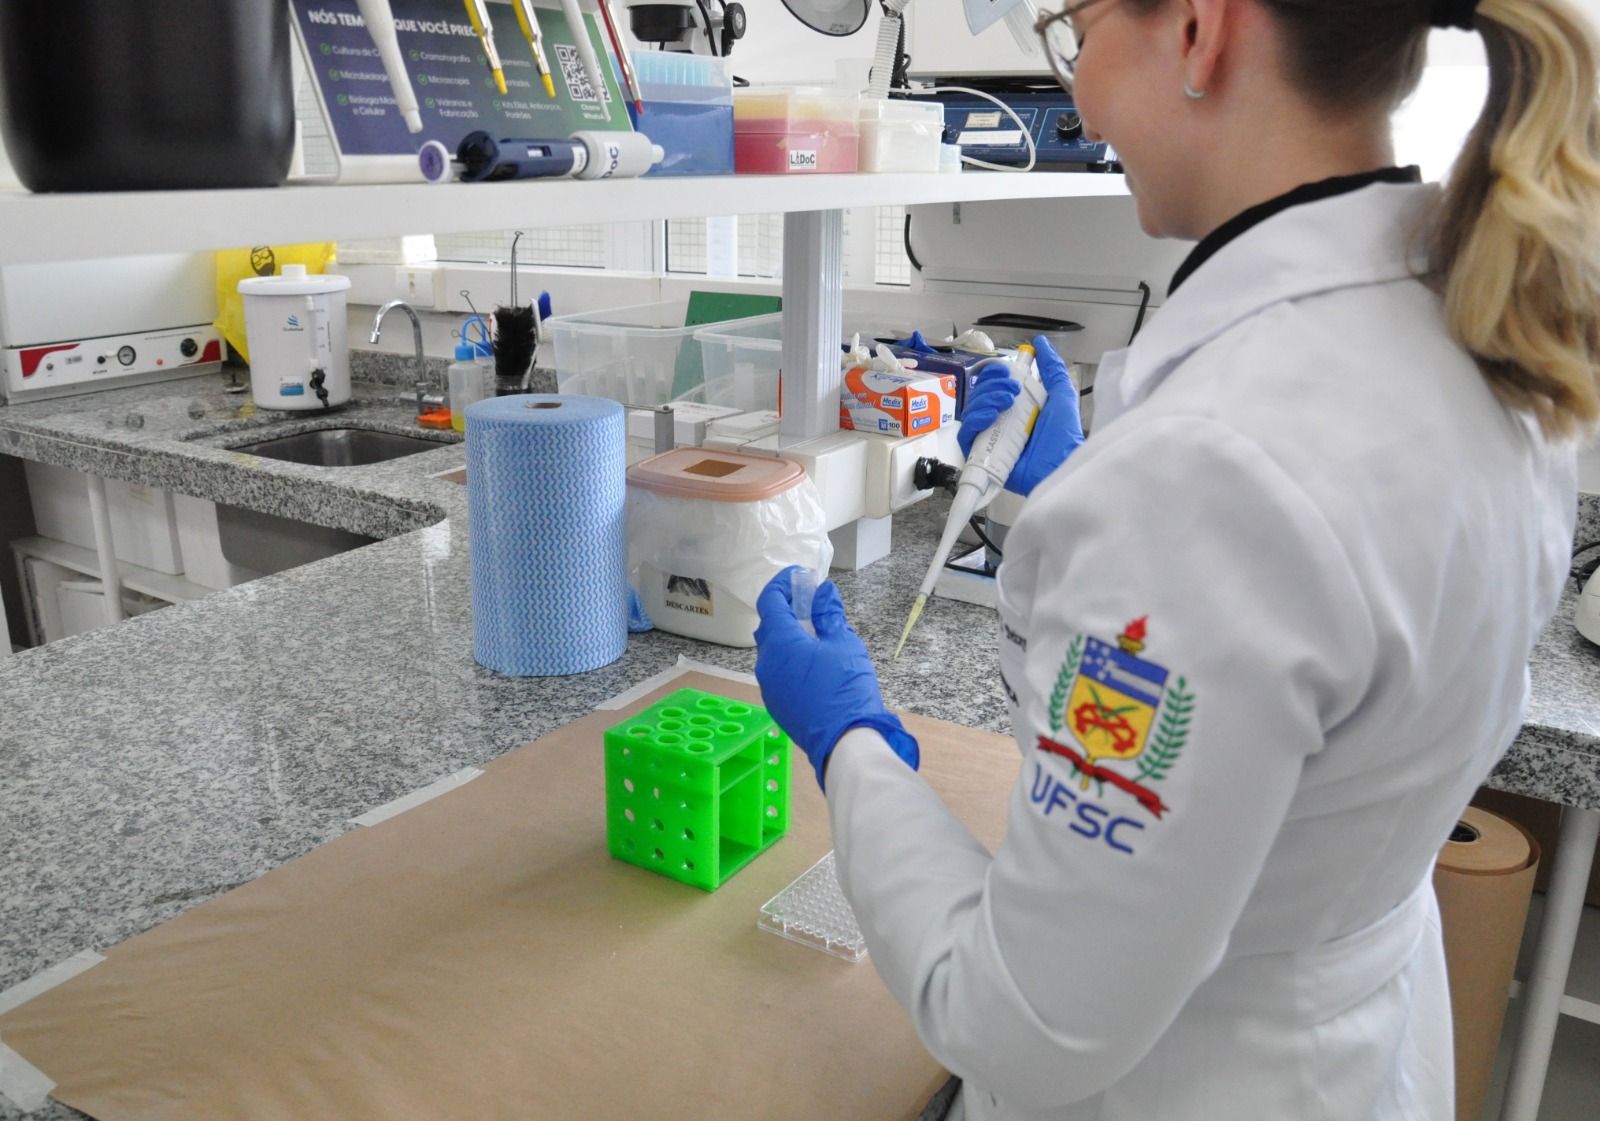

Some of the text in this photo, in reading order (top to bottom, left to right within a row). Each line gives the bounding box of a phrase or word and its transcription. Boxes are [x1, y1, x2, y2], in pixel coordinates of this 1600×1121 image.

[308, 9, 479, 37] NÓS TEM QUE VOCÊ PREC
[331, 45, 361, 56] Cultura
[361, 47, 372, 56] de
[420, 51, 471, 64] Cromatografia
[339, 70, 388, 83] Microbiolog
[427, 75, 470, 86] Microscopia
[348, 95, 379, 106] Biologia
[358, 106, 386, 116] Celular
[439, 108, 479, 119] Fabricação
[582, 112, 605, 120] WhatsA
[882, 397, 902, 406] Medix
[911, 397, 927, 408] Medix
[986, 429, 1001, 453] KASVI
[666, 600, 709, 615] DESCARTES
[1031, 763, 1145, 854] UFSC
